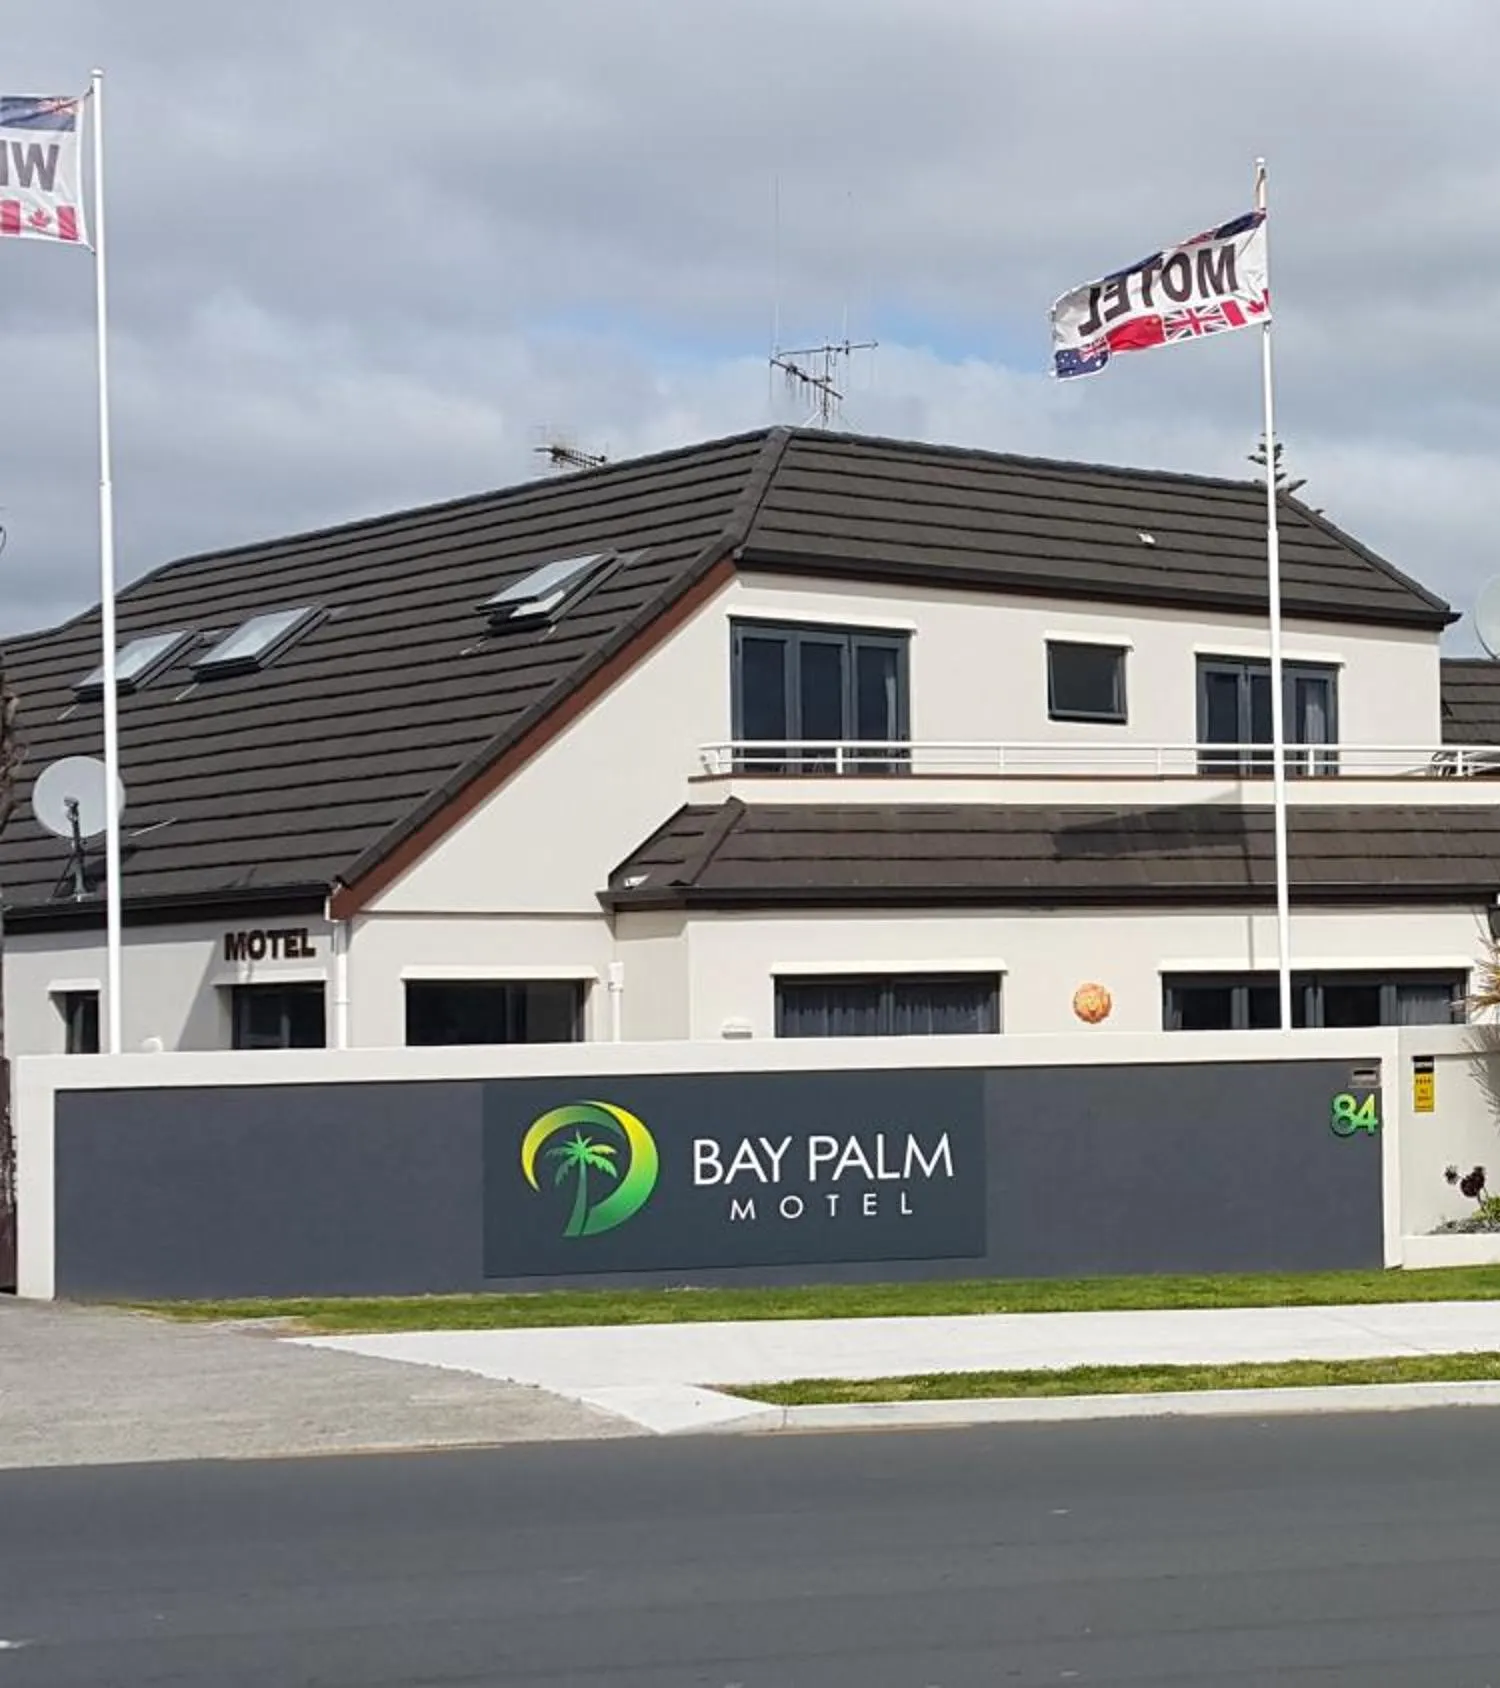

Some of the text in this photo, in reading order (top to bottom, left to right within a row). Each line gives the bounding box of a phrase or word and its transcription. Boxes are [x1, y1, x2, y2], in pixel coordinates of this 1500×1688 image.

[224, 927, 316, 961] MOTEL
[1330, 1092, 1378, 1137] 84
[693, 1132, 954, 1185] BAY PALM
[730, 1191, 913, 1220] MOTEL
